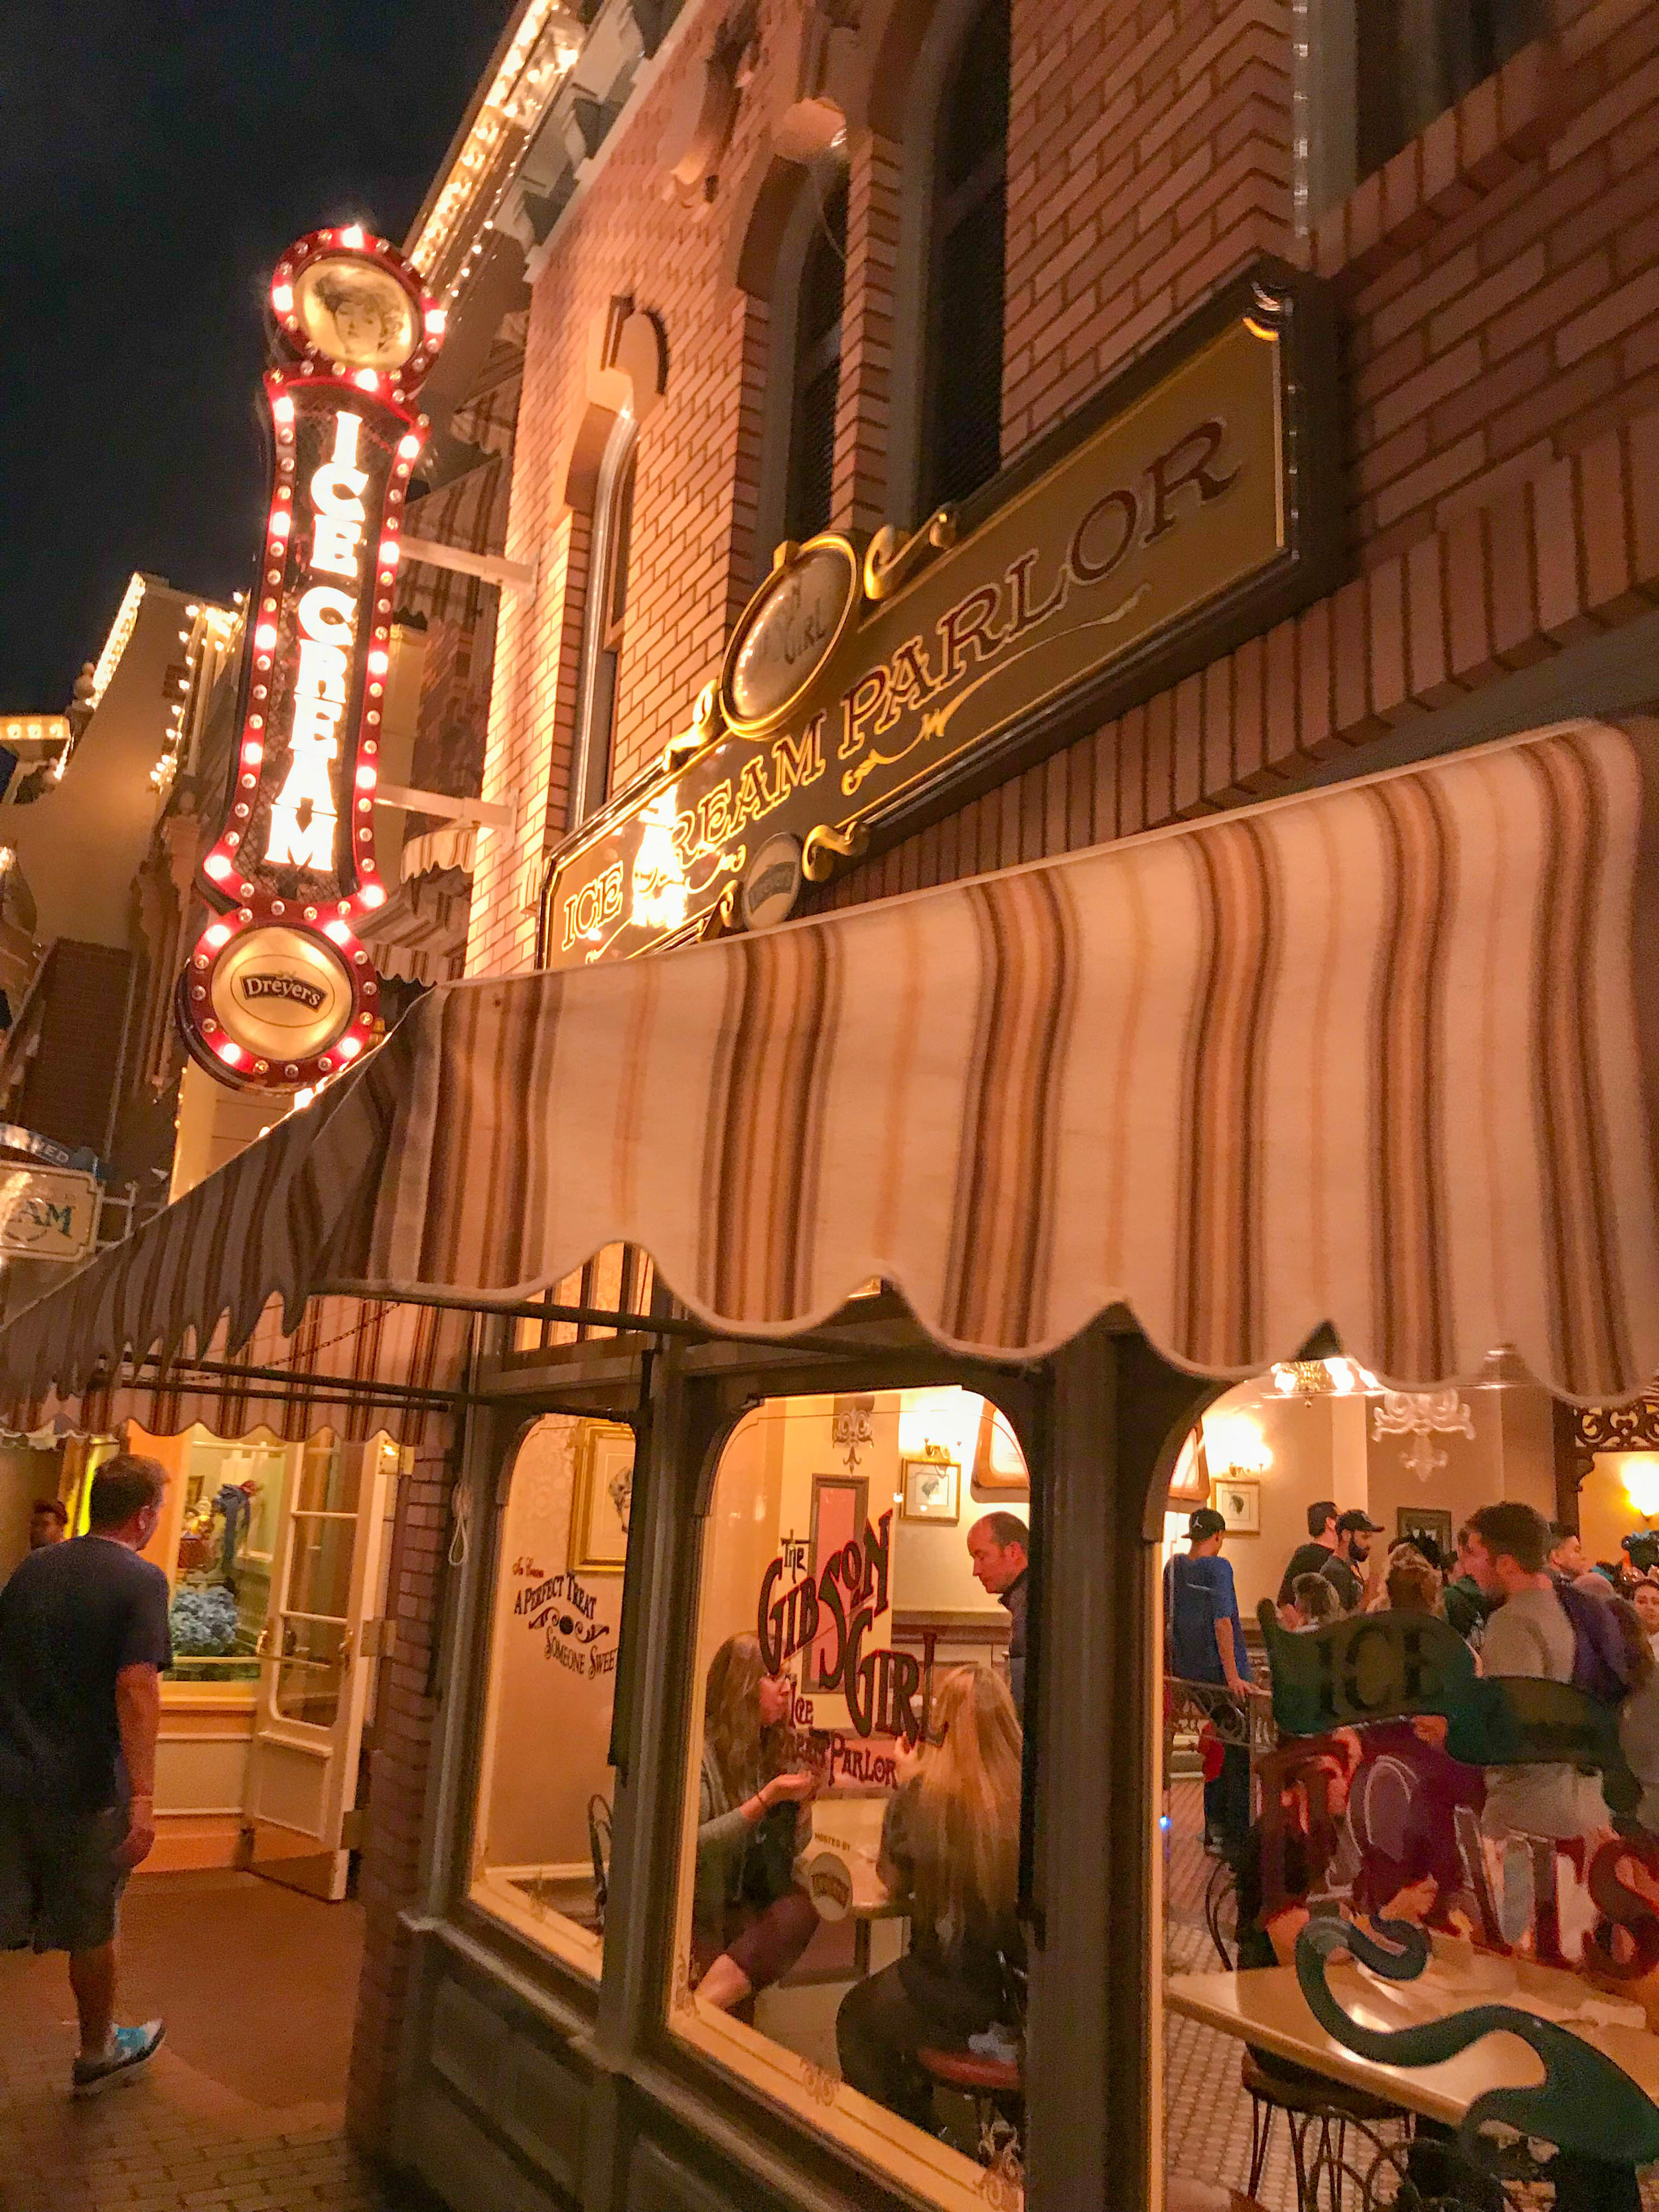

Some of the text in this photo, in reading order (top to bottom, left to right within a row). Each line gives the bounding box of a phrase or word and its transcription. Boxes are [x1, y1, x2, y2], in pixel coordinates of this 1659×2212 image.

[310, 411, 369, 577] ICE
[263, 585, 358, 873] CREAM
[561, 860, 624, 951] ICE
[837, 415, 1243, 759] PARLOR
[514, 1589, 523, 1615] A
[566, 1570, 597, 1620] TREAT
[544, 1625, 585, 1675] SOMEONE
[758, 1508, 893, 1690] GIBSON
[844, 1607, 950, 1749] GIRL
[828, 1732, 899, 1790] PARLOR
[814, 1831, 851, 1852] HOSTED BY
